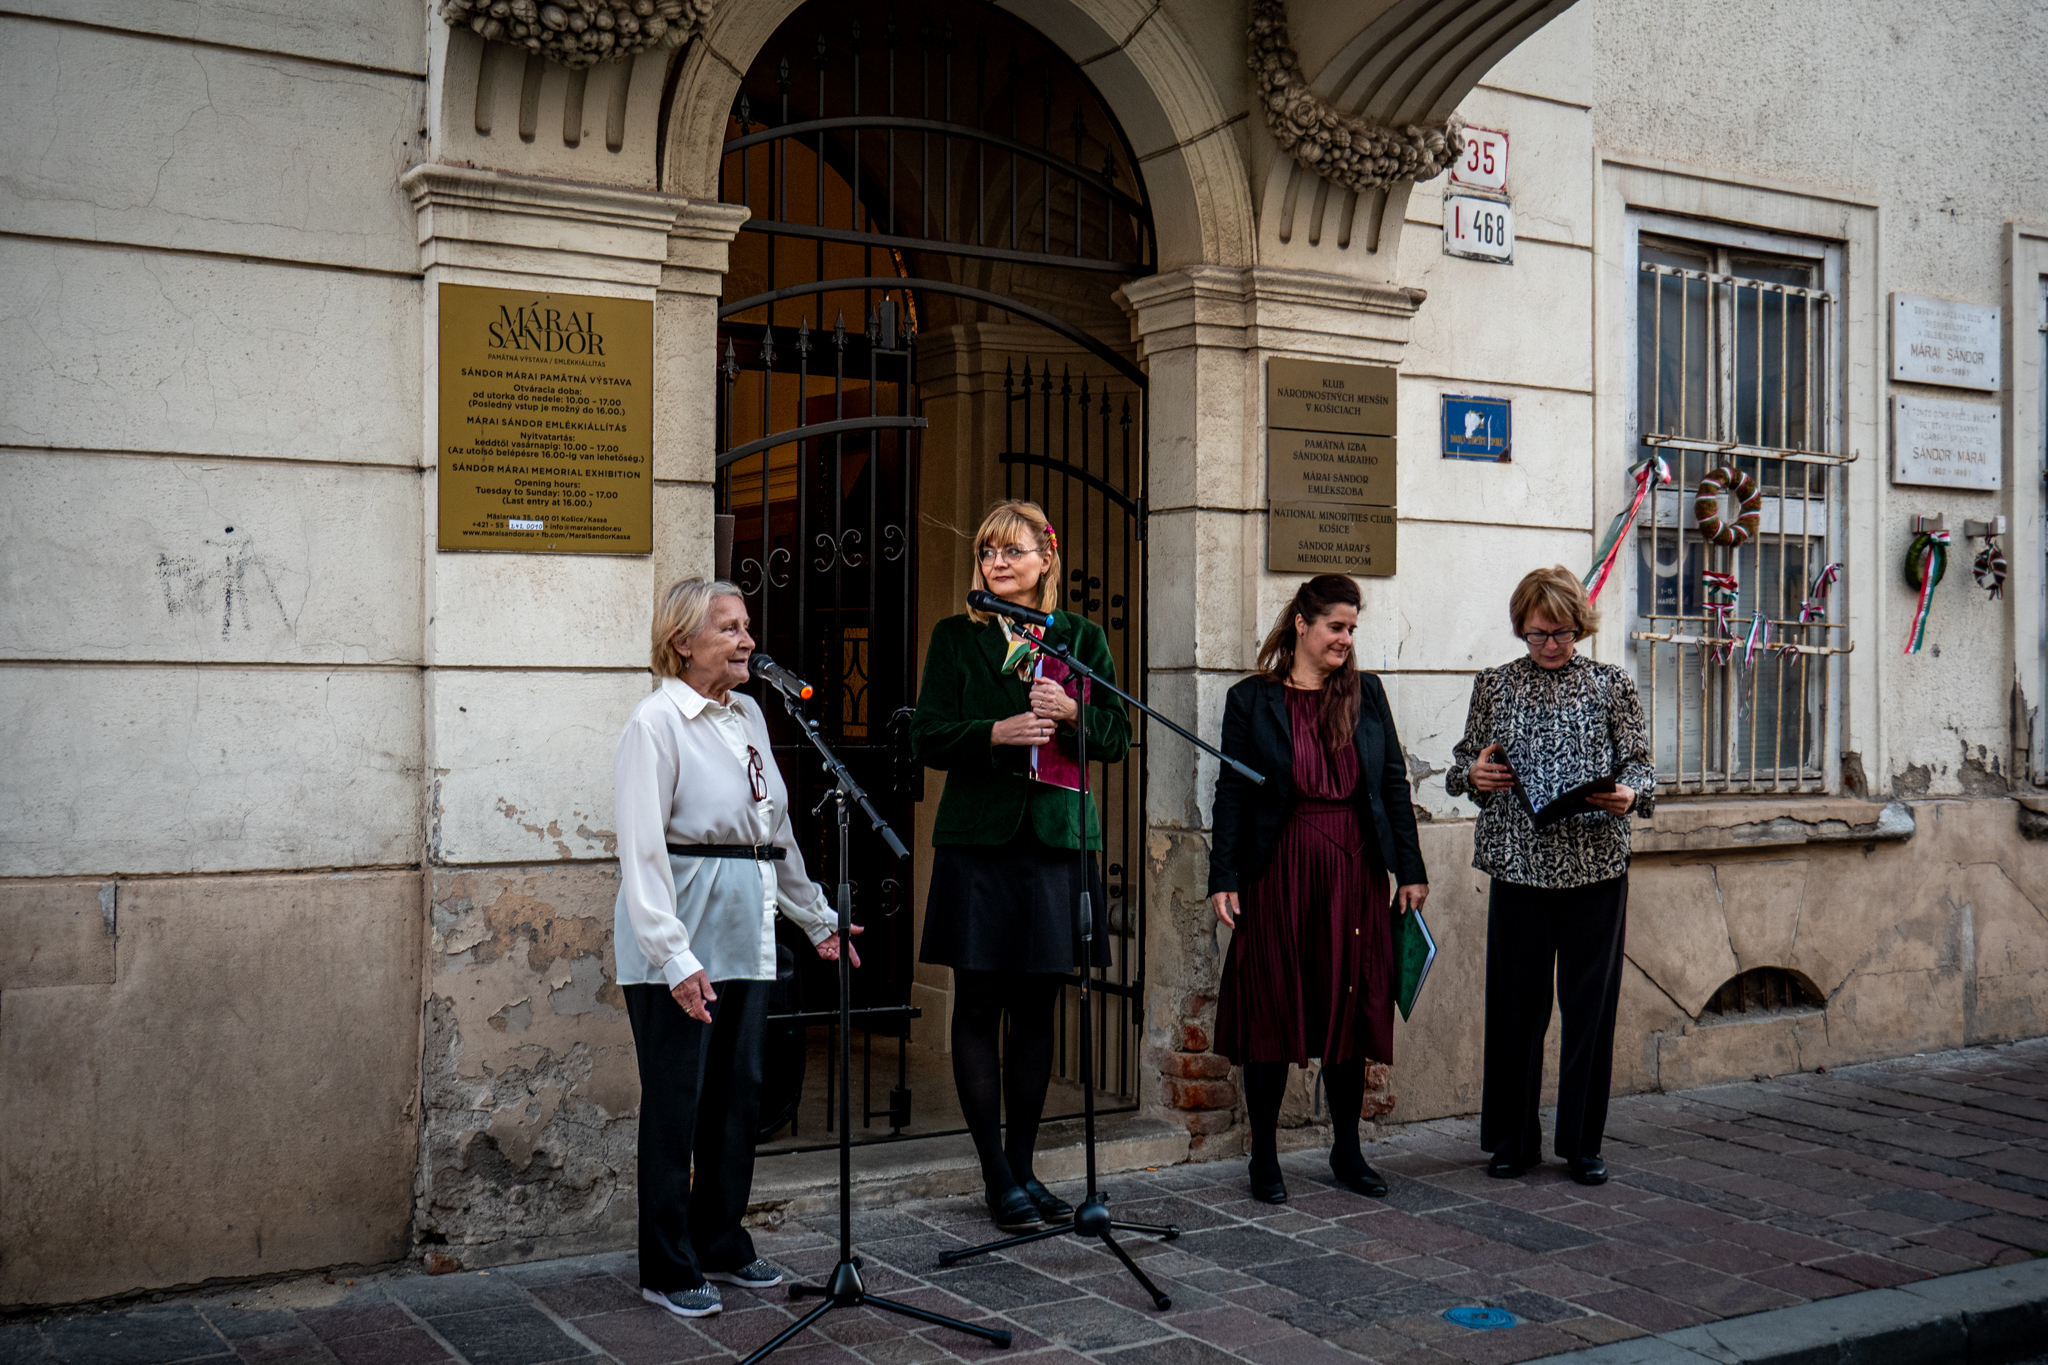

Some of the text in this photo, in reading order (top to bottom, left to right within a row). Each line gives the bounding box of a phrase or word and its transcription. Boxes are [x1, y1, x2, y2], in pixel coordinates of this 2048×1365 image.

[1468, 139, 1495, 174] 35
[1473, 210, 1504, 246] 468
[499, 301, 594, 337] MÁRAI
[488, 320, 606, 356] SÁNDOR
[1911, 342, 1984, 364] MÁRAI SÁNDOR
[488, 354, 518, 362] PAMÄTNÁ
[520, 355, 548, 364] VÝSTAVA
[554, 358, 606, 368] EMLÉKKIÁLLÍTÁS
[461, 367, 632, 386] SÁNDOR MÁRAI PAMÄTNÁ VÝSTAVA
[514, 384, 582, 395] Otváracia doba:
[1322, 379, 1345, 389] KLUB
[473, 391, 484, 399] od
[487, 392, 515, 400] utorka
[532, 395, 563, 403] nedele:
[566, 396, 590, 404] 10.00
[599, 398, 621, 406] 17.00
[1277, 386, 1389, 405] NÁRODNOSTNÝCH MENŠÍN
[468, 399, 512, 410] (Posledný
[515, 403, 539, 412] vstup
[541, 403, 549, 412] je
[551, 405, 580, 414] možný
[596, 407, 625, 416] 16.00.)
[1305, 403, 1361, 415] V KOŠICIACH
[466, 415, 627, 432] MÁRAI SÁNDOR EMLÉKKIÁLLÍTÁS
[520, 432, 575, 442] Nyitvatartás:
[511, 441, 561, 450] vasárnapig:
[563, 443, 587, 451] 10.00
[597, 444, 619, 452] 17.00
[1304, 439, 1366, 451] PAMÄTNÁ IZBA
[448, 446, 464, 454] (Az
[466, 447, 494, 456] utolsó
[496, 448, 539, 458] belépésre
[541, 451, 577, 460] 16.00-ig
[1293, 450, 1378, 465] SÁNDORA MÁRAIHO
[1913, 445, 1986, 465] SÁNDOR MÁRAI
[452, 462, 640, 478] SÁNDOR MÁRAI MEMORIAL EXHIBITION
[514, 478, 581, 488] Opening hours:
[1303, 471, 1369, 484] MÁRAI SÁNDOR
[476, 486, 511, 496] Tuesday
[526, 488, 560, 498] Sunday:
[596, 491, 618, 499] 17.00
[1308, 484, 1363, 496] EMLÉKSZOBA
[502, 497, 524, 505] (Last
[526, 498, 549, 507] entry
[563, 499, 592, 508] 16.00.)
[561, 515, 607, 523] Košice/Kassa
[1274, 508, 1316, 519] NATIONAL
[1318, 511, 1368, 522] MINORITIES
[550, 524, 622, 532] info@maraisandor.eu
[1319, 523, 1350, 534] KOŠICE
[541, 531, 630, 540] fb.com/MaraiSandorKassa
[1298, 540, 1334, 551] SÁNDOR
[1297, 554, 1371, 565] MEMORIAL ROOM
